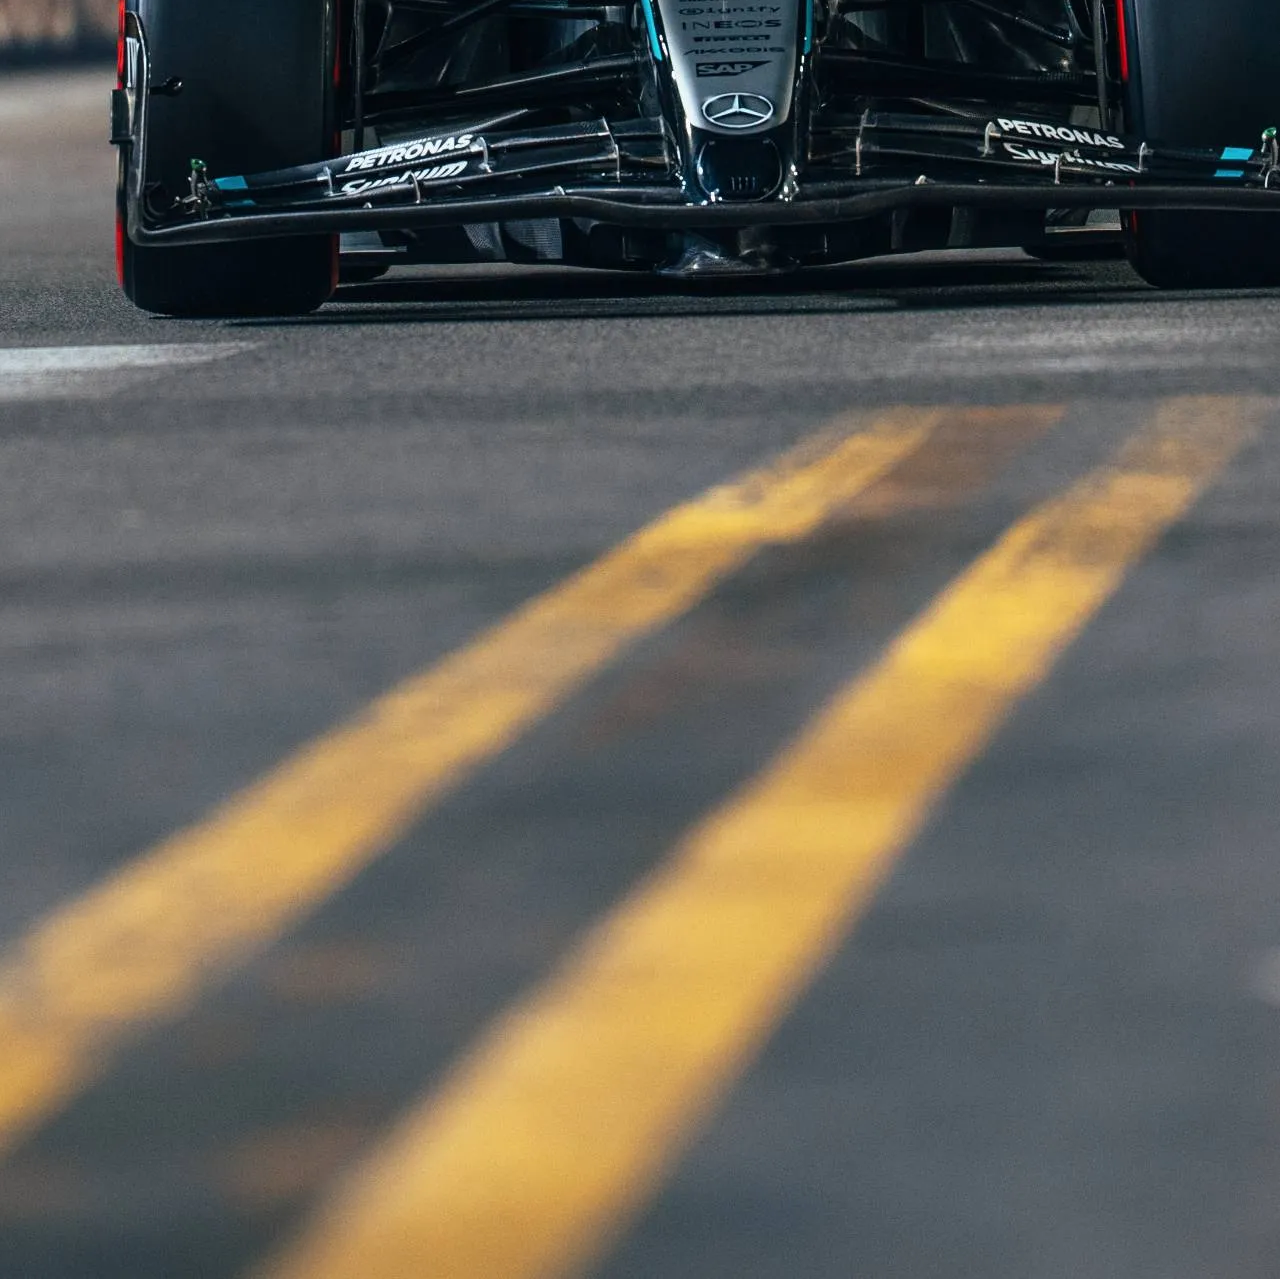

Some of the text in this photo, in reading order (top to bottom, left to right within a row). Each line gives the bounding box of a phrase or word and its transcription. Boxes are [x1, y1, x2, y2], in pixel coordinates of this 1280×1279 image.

[682, 19, 782, 31] INEOS
[997, 118, 1125, 149] PETRONAS
[344, 133, 474, 172] PETRONAS
